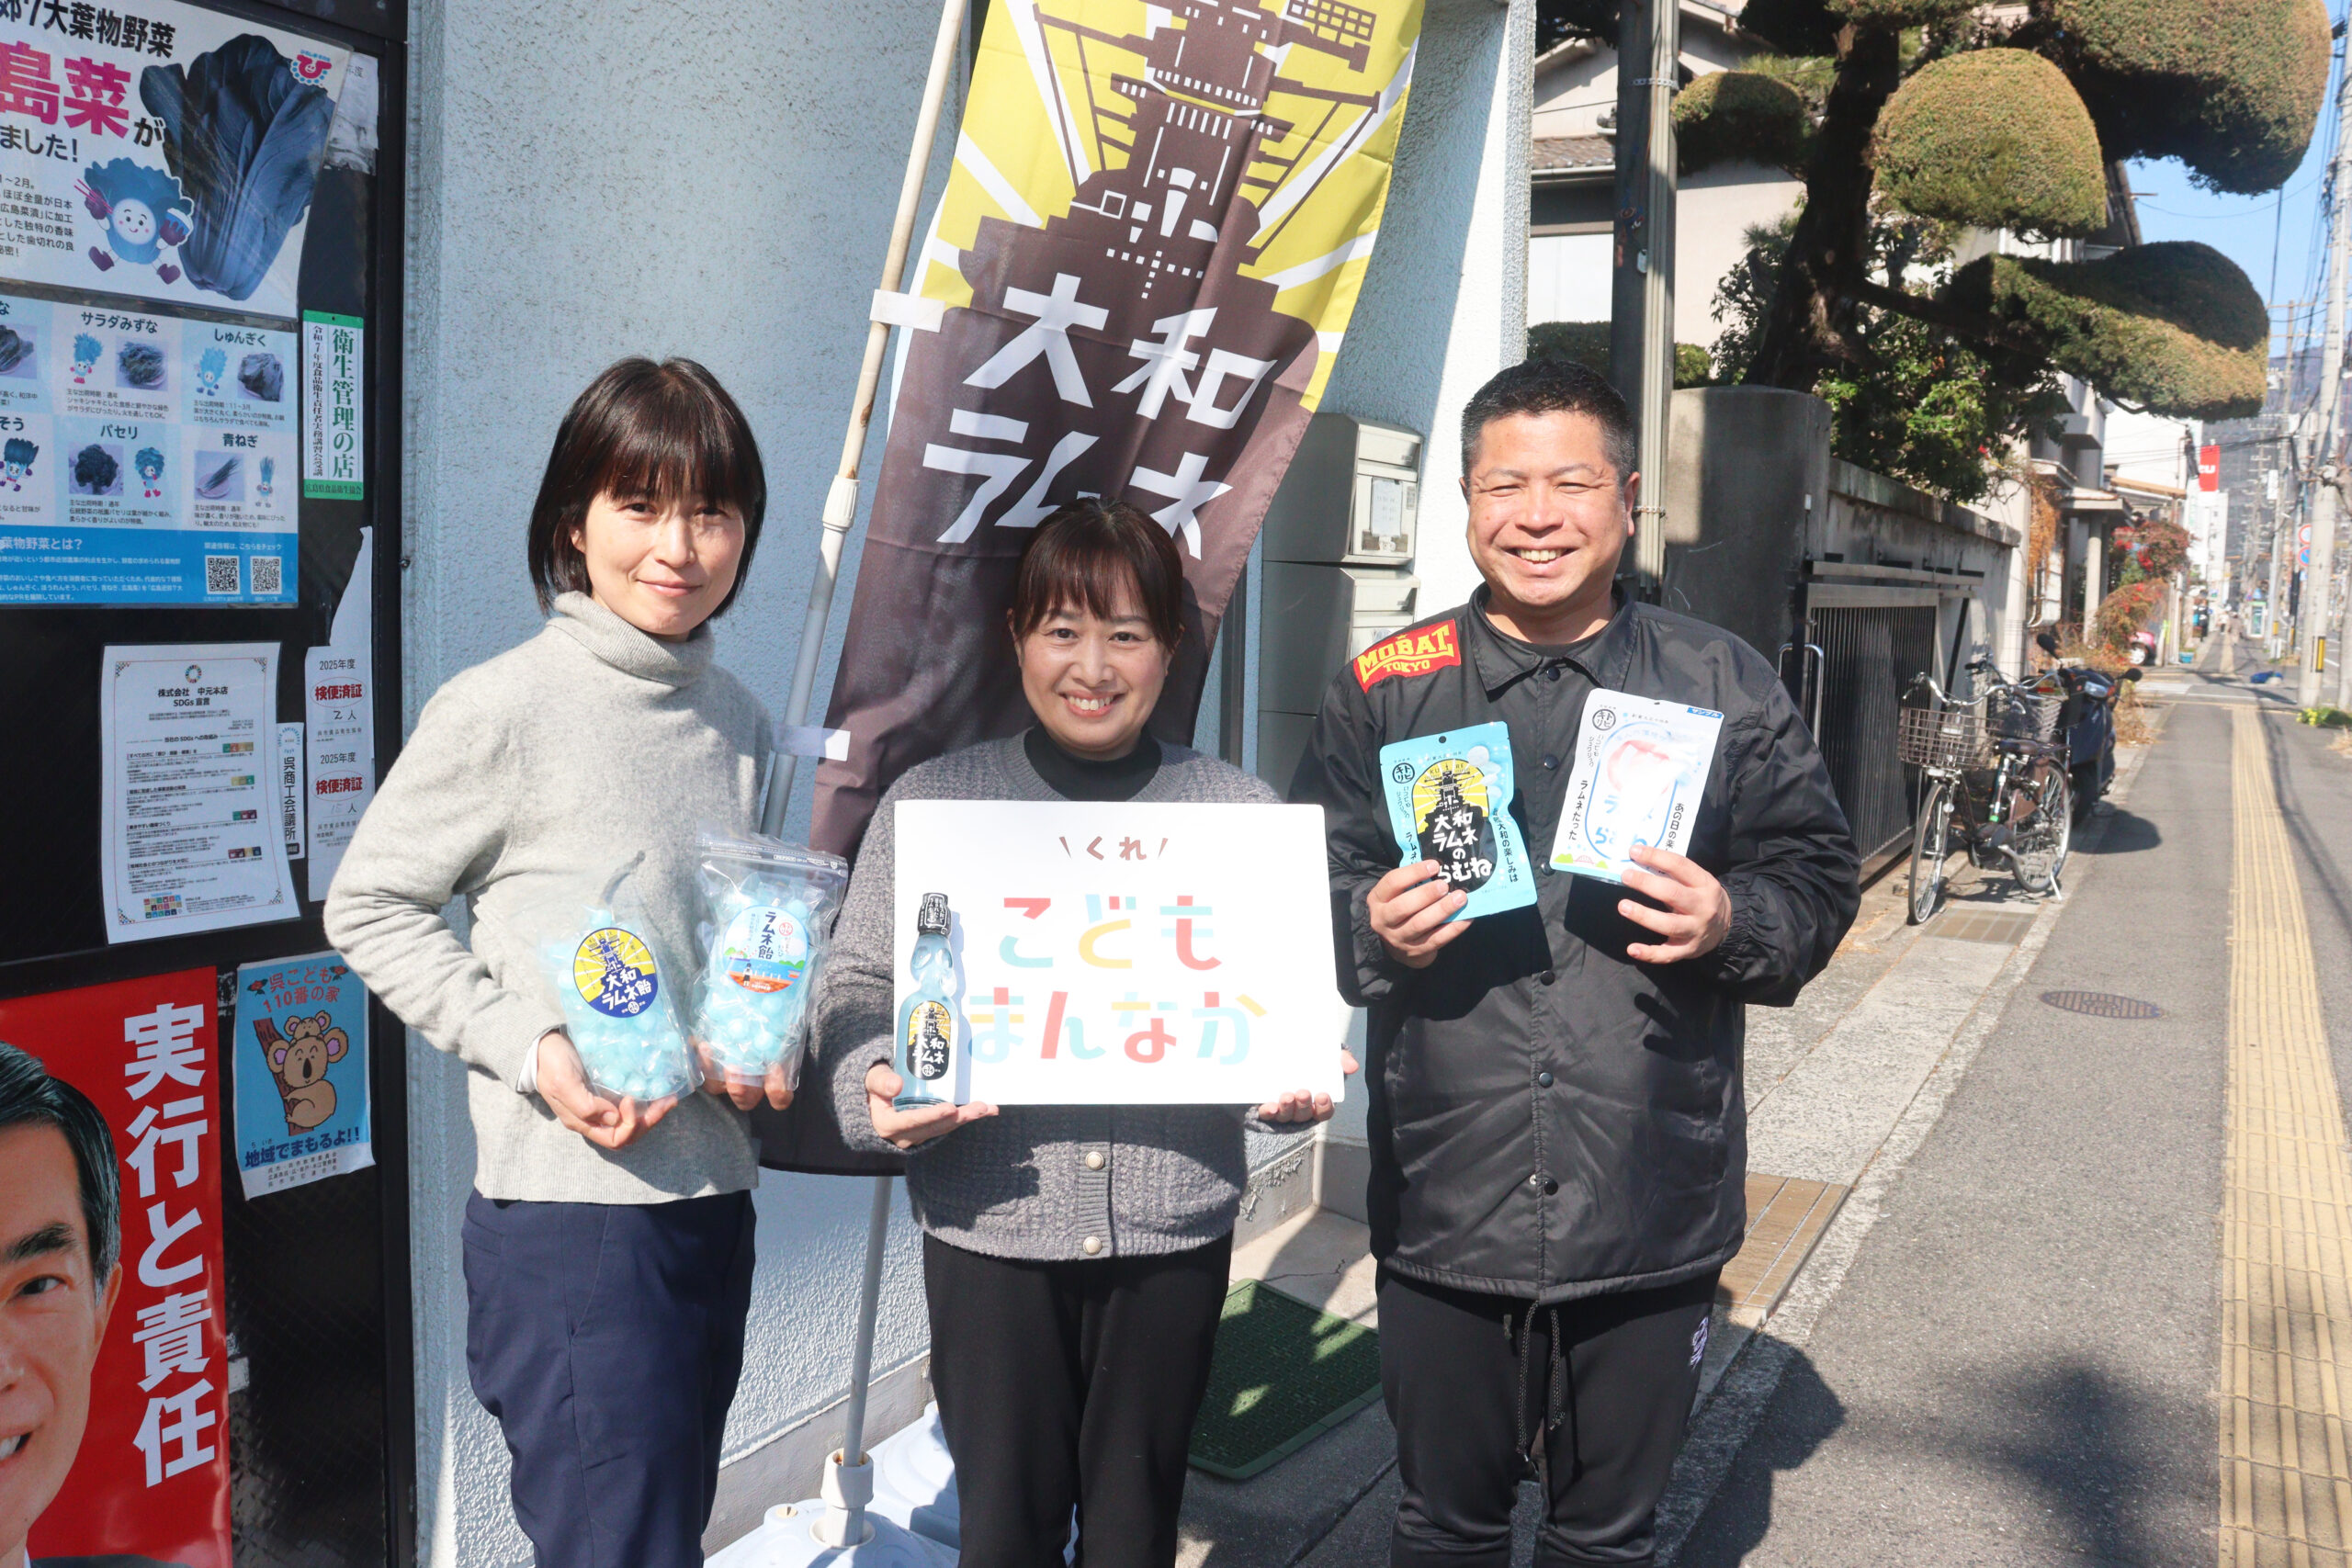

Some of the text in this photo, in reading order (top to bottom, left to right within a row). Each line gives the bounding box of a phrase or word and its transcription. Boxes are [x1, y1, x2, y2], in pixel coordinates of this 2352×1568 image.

[81, 311, 158, 333] サラダみずな
[214, 328, 267, 347] しゅんぎく
[962, 272, 1278, 430] 大和
[332, 328, 355, 479] 衛生管理の店
[100, 424, 139, 439] パセリ
[222, 433, 258, 448] 青ねぎ
[319, 659, 356, 671] 2025年度
[1357, 625, 1454, 683] MOBAT
[1384, 660, 1430, 672] TOKYO
[314, 683, 363, 701] 検便済証
[348, 710, 356, 720] 人
[320, 752, 356, 765] 2025年度
[284, 756, 297, 840] 呉商工会議所
[315, 776, 363, 795] 検便済証
[1433, 811, 1474, 833] 大和
[1568, 780, 1589, 840] ラムネたった
[1666, 803, 1685, 850] あの日の楽
[1086, 836, 1148, 861] くれ
[1406, 831, 1419, 864] ラムネ
[1431, 828, 1479, 852] ラムネ
[1453, 848, 1466, 860] の
[758, 911, 777, 960] ラムネ飴
[999, 894, 1223, 971] こども
[268, 967, 333, 993] 呉こども
[606, 968, 638, 991] 大和
[263, 986, 341, 1013] 110番の家
[602, 978, 652, 1010] ラムネ飴
[967, 987, 1268, 1066] まんなか
[244, 1126, 360, 1168] 地域でまもるよ!!
[124, 1002, 215, 1488] 実行と責任
